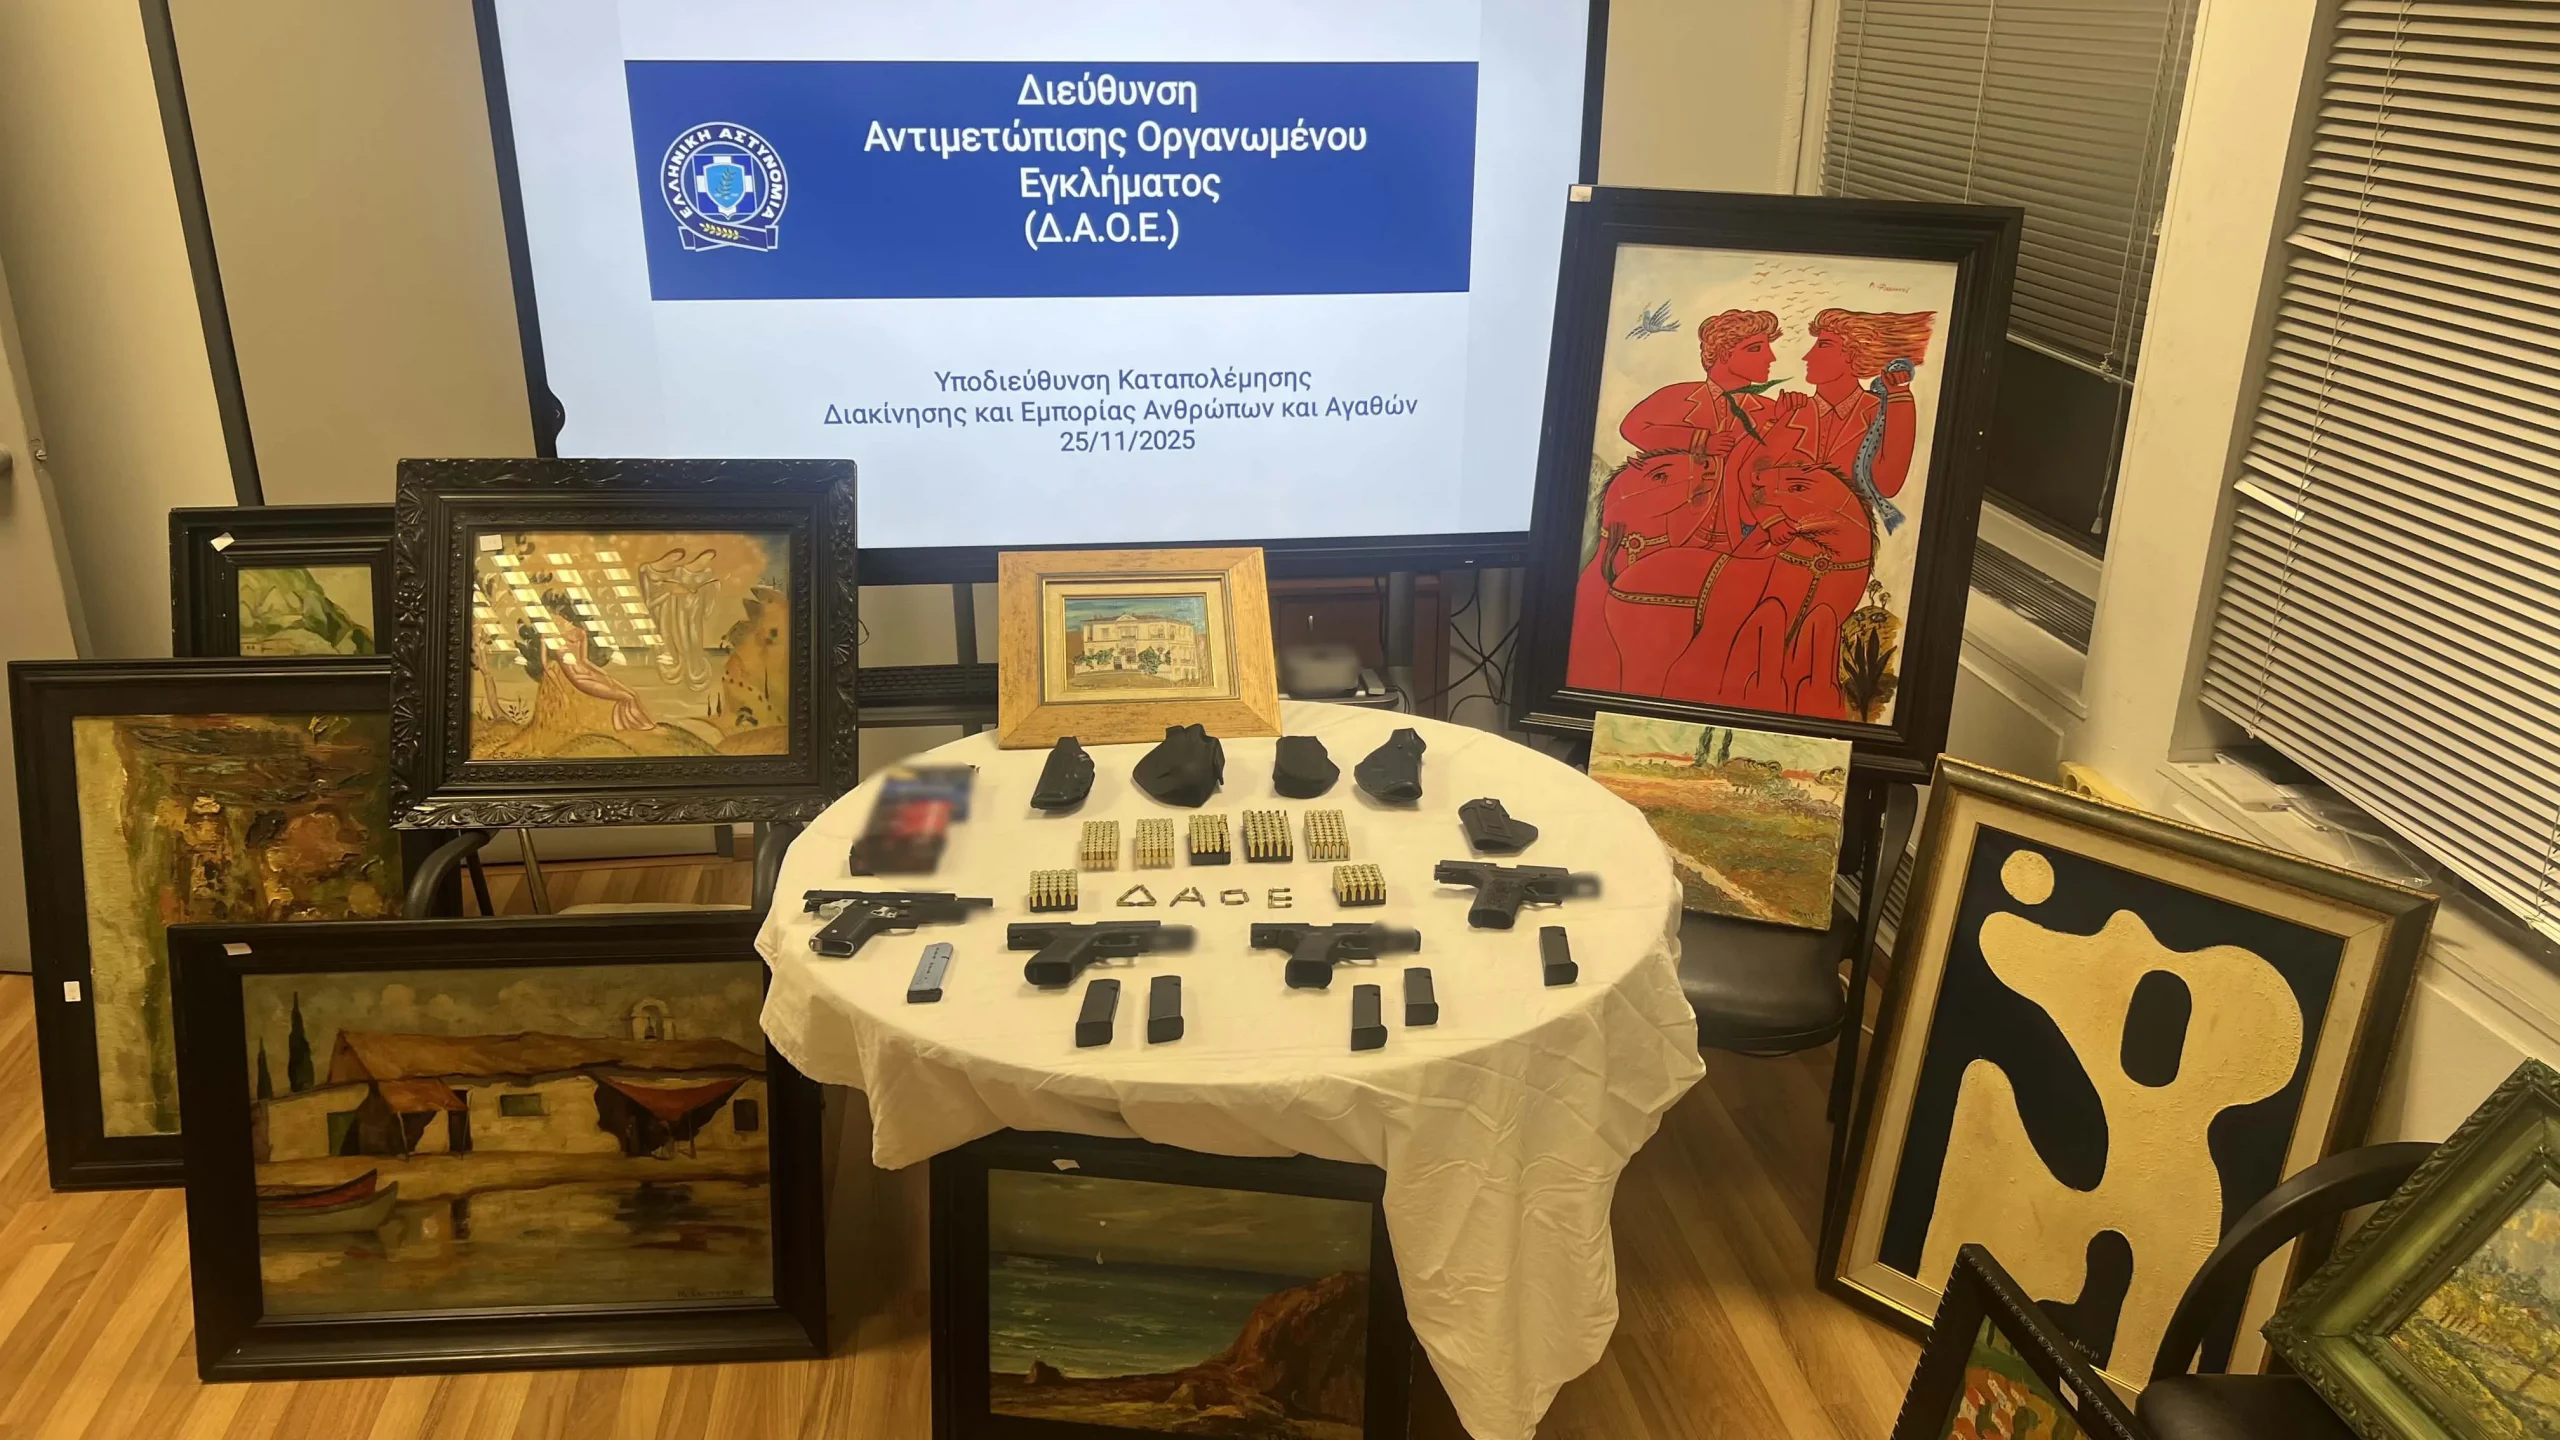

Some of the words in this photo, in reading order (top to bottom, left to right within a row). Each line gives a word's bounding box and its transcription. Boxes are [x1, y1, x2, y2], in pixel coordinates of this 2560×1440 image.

[1018, 72, 1197, 115] Διεύθυνση
[864, 119, 1128, 159] Αντιμετώπισης
[1138, 117, 1368, 159] Οργανωμένου
[667, 128, 712, 220] ΕΛΛΗΝΙΚΗ
[718, 127, 785, 220] ΑΣΤΥΝΟΜΙΑ
[1019, 164, 1221, 206] Εγκλήματος
[1024, 210, 1180, 252] (Δ.Α.Ο.Ε.)
[934, 369, 1110, 396] Υποδιεύθυνση
[1119, 366, 1312, 395] Καταπολέμησης
[823, 401, 967, 428] Διακίνησης
[976, 405, 1014, 423] και
[1022, 398, 1136, 427] Εμπορίας
[1144, 397, 1275, 425] Ανθρώπων
[1282, 400, 1319, 418] και
[1325, 394, 1418, 422] Αγαθών
[1060, 430, 1196, 453] 25/11/2025
